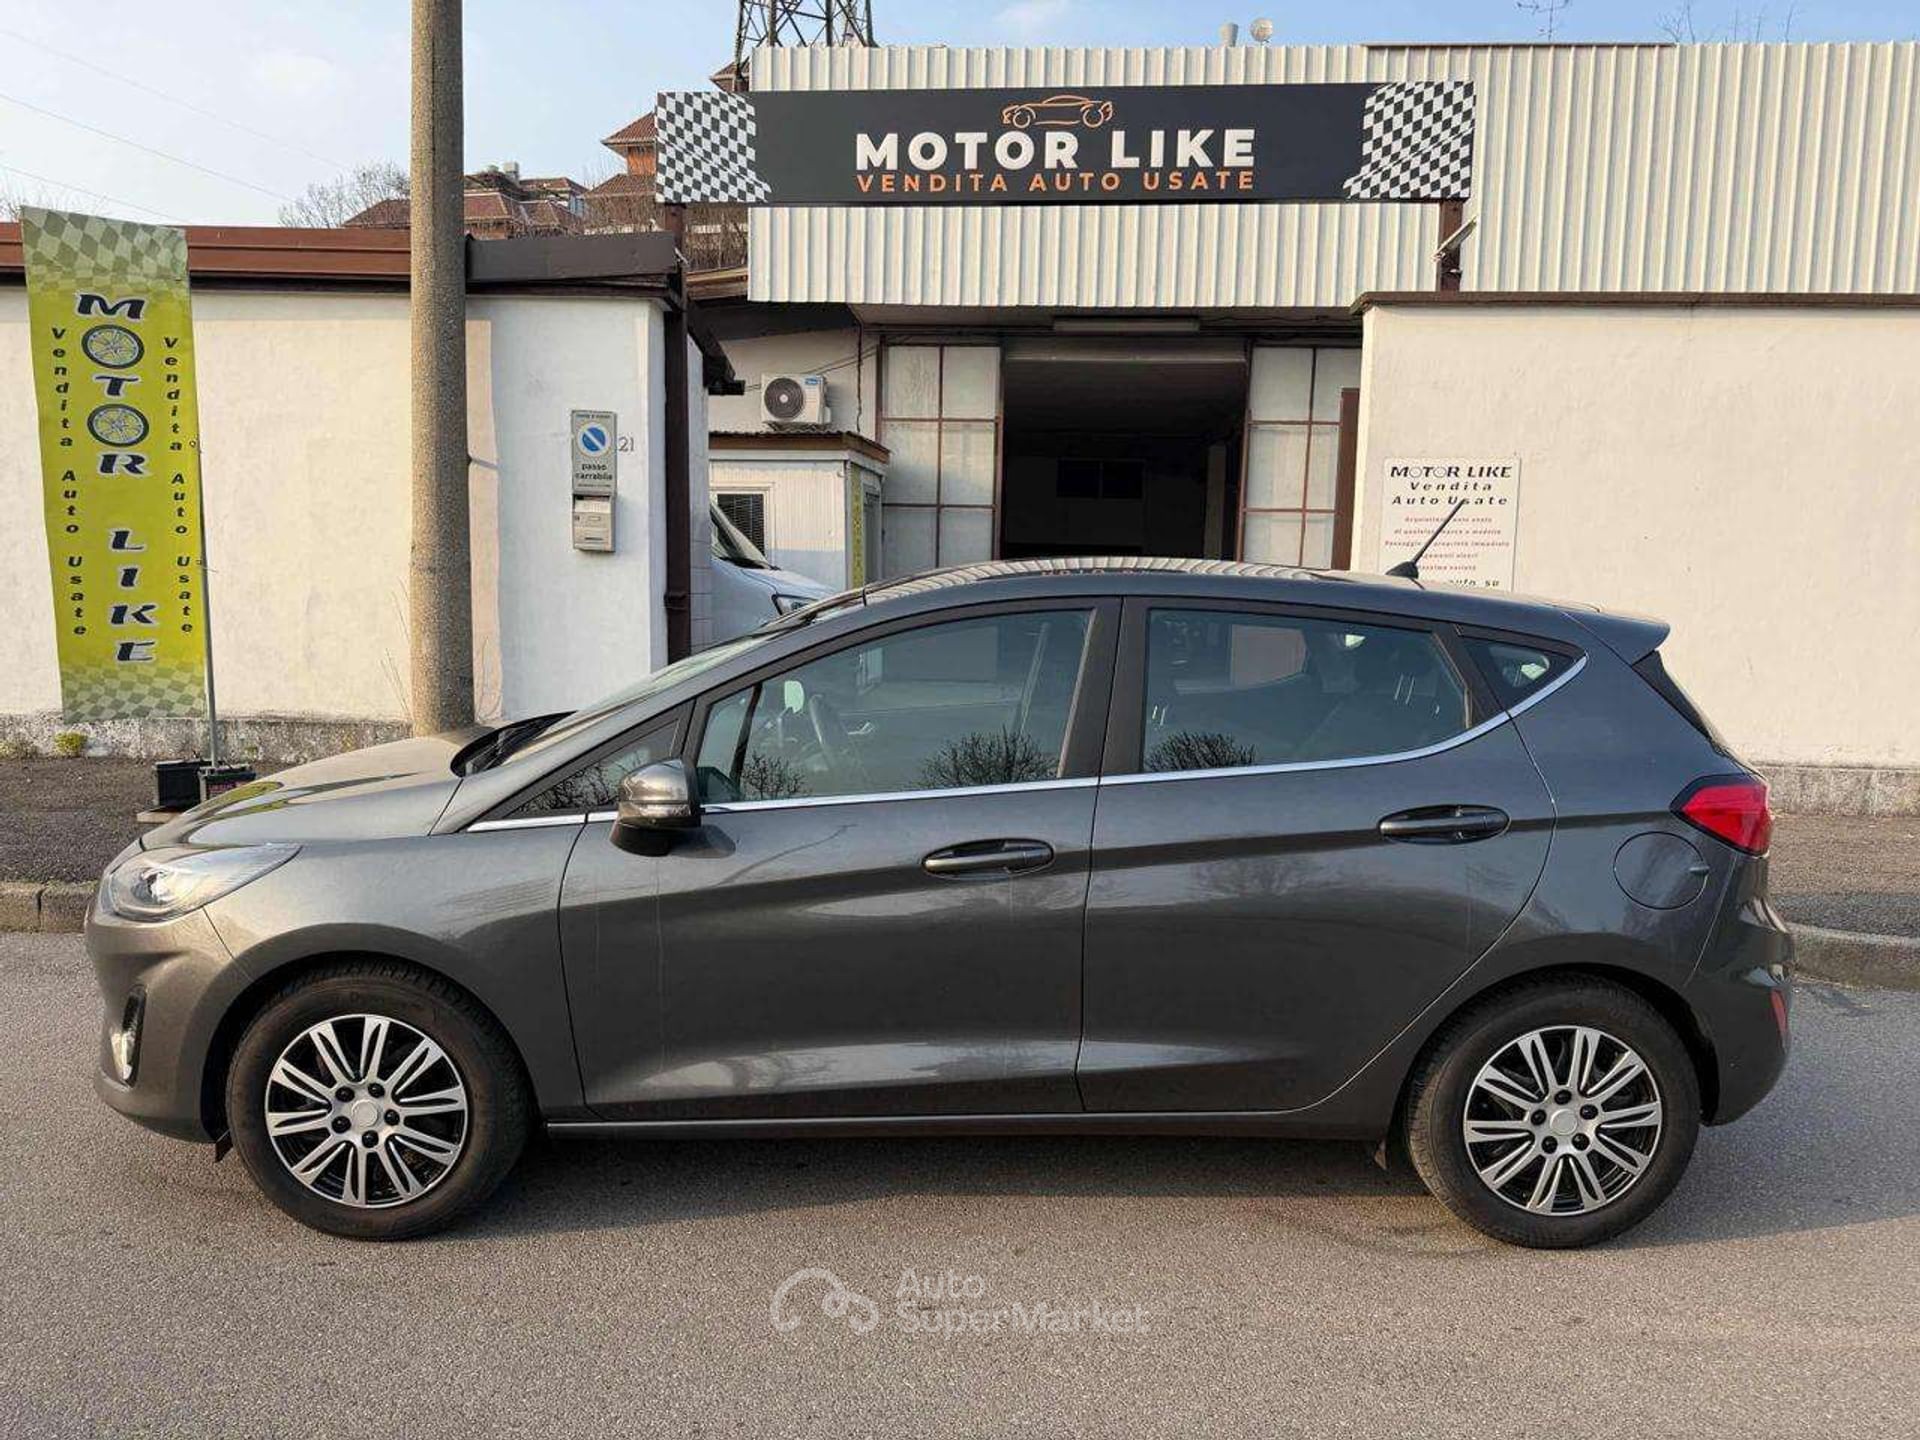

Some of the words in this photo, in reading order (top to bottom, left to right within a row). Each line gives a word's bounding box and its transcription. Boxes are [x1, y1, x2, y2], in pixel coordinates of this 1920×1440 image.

[856, 131, 1079, 171] MOTOR
[1111, 128, 1255, 168] LIKE
[856, 173, 1008, 193] VENDITA
[1028, 172, 1121, 192] AUTO
[1142, 170, 1254, 191] USATE
[51, 327, 73, 447] Vendita
[164, 336, 183, 451] Vendita
[582, 463, 608, 471] passo
[1390, 466, 1460, 478] MOTOR
[1467, 466, 1512, 478] LIKE
[1410, 481, 1492, 491] Vendita
[61, 470, 79, 534] Auto
[171, 473, 188, 534] Auto
[1392, 496, 1439, 504] Auto
[1448, 496, 1507, 505] Usate
[67, 556, 87, 635] Usate
[111, 530, 156, 662] LIKE
[176, 556, 193, 633] Usate
